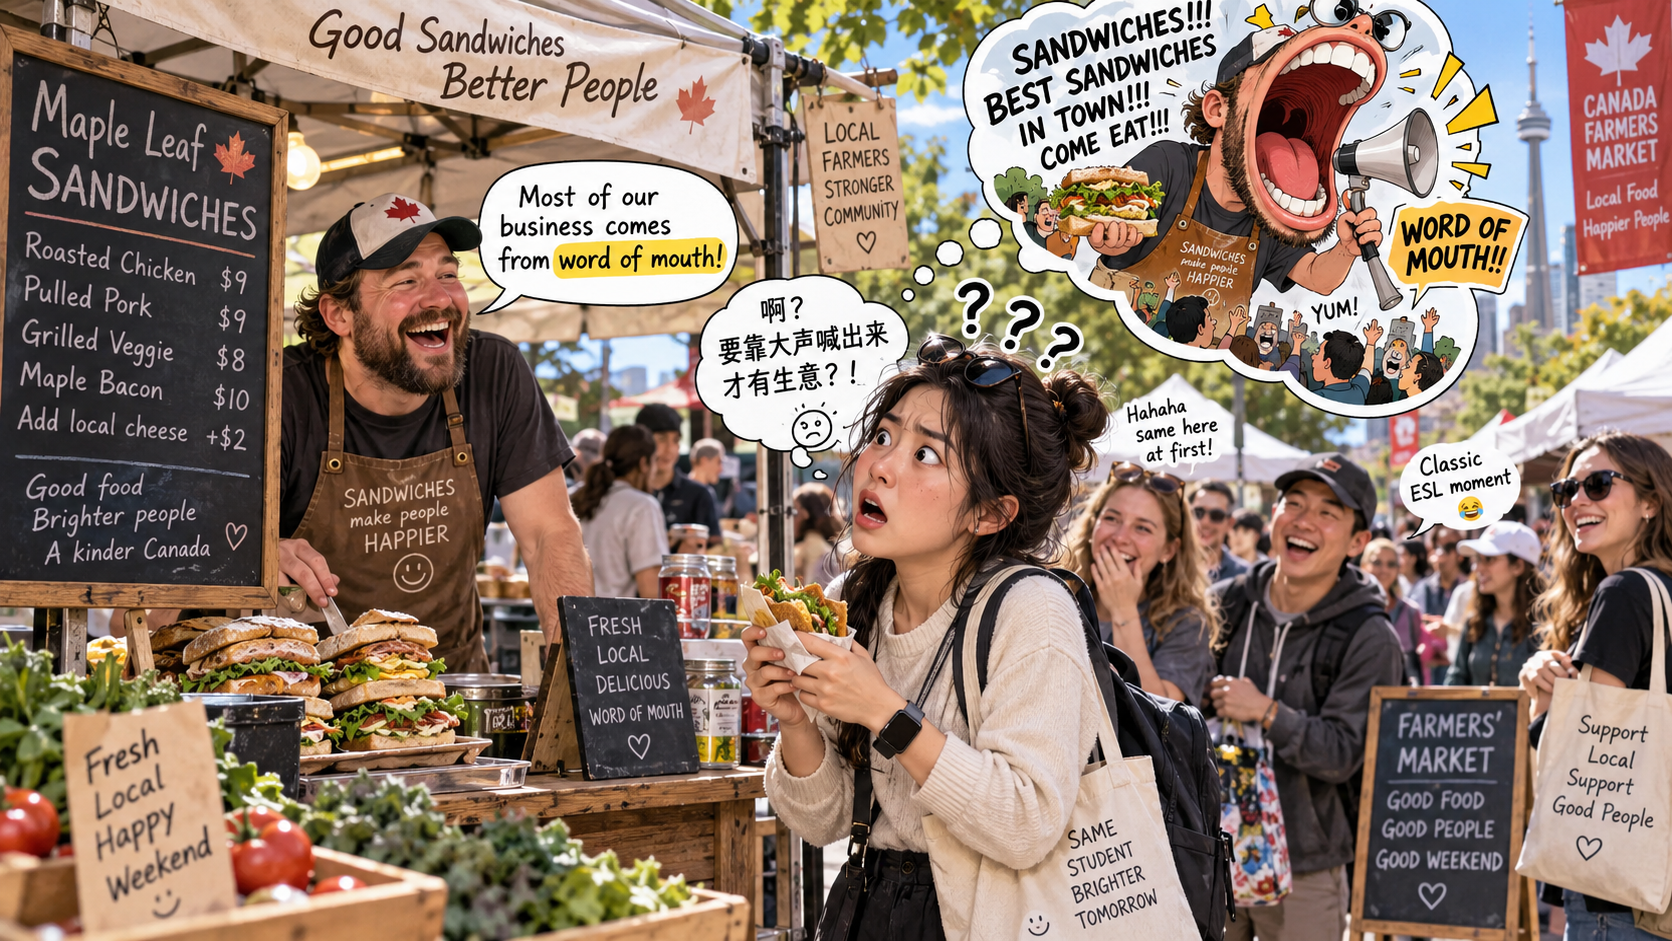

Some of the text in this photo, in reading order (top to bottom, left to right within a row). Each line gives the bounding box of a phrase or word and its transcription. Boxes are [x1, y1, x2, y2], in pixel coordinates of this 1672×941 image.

[308, 8, 565, 60] Good Sandwiches
[440, 61, 659, 118] Better People
[1583, 85, 1657, 119] CANADA
[31, 79, 207, 172] Maple Leaf
[824, 121, 880, 144] LOCAL
[1585, 112, 1658, 144] FARMERS
[822, 148, 890, 172] FARMERS
[1586, 138, 1659, 172] MARKET
[28, 147, 257, 241] SANDWICHES
[824, 174, 894, 199] STRONGER
[1587, 179, 1658, 210] Local Food
[824, 200, 899, 227] COMMUNITY
[1583, 208, 1670, 241] Happier People
[25, 231, 247, 295] Roasted Chicken $9
[25, 275, 246, 334] Pulled Pork $9
[22, 319, 245, 372] Grilled Veggie $8
[20, 361, 250, 411] Maple Bacon $10
[17, 405, 247, 451] Add local cheese +$2
[26, 473, 145, 500] Good food
[344, 479, 456, 508] SANDWICHES
[32, 499, 197, 537] Brighter people
[350, 501, 449, 532] make people
[44, 534, 211, 565] A kinder Canada
[365, 524, 449, 553] HAPPIER
[588, 614, 642, 637] FRESH
[597, 644, 649, 665] LOCAL
[596, 672, 670, 695] DELICIOUS
[589, 707, 626, 726] WORD
[630, 704, 643, 723] OF
[647, 701, 684, 720] MOUTH
[1398, 710, 1502, 739] FARMERS'
[1578, 714, 1648, 744] Support
[85, 729, 160, 784] Fresh
[1396, 746, 1495, 774] MARKET
[1587, 745, 1635, 770] Local
[95, 763, 165, 819] Local
[1567, 768, 1634, 797] Support
[1387, 790, 1485, 812] GOOD FOOD
[1553, 795, 1654, 832] Good People
[95, 802, 175, 861] Happy
[1067, 819, 1118, 850] SAME
[1382, 819, 1495, 839] GOOD PEOPLE
[106, 826, 213, 902] Weekend
[1067, 840, 1133, 877] STUDENT
[1376, 849, 1503, 872] GOOD WEEKEND
[1071, 865, 1146, 904] BRIGHTER
[1074, 887, 1158, 930] TOMORROW
